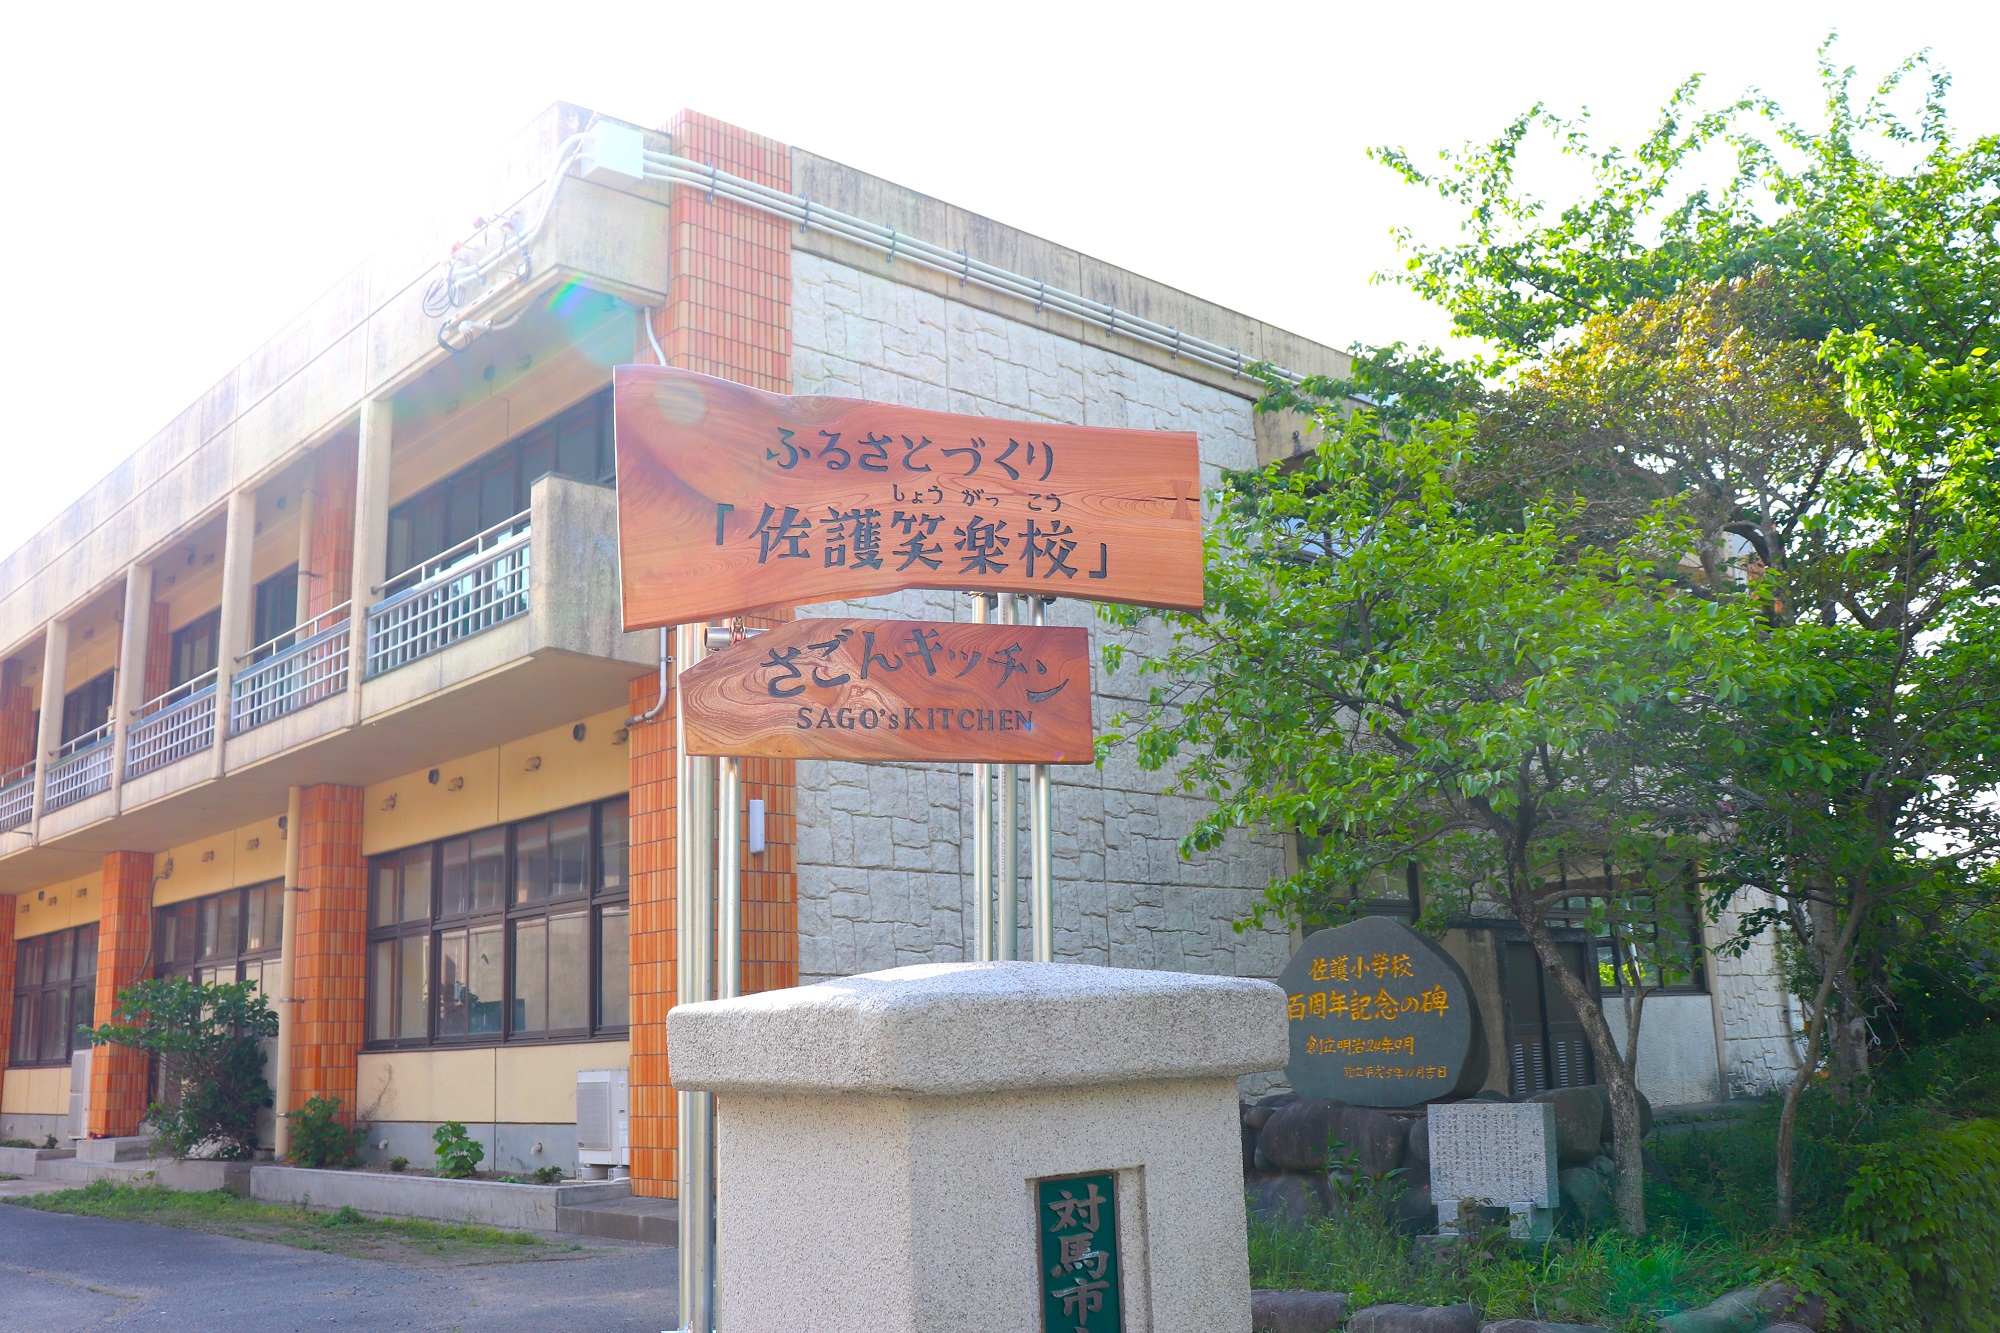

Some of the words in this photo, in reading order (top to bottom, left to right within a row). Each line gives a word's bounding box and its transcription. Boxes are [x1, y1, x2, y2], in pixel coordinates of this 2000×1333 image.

[766, 426, 1054, 482] ふるさとづくり
[893, 484, 945, 506] しょう
[961, 487, 1000, 507] がっ
[1027, 492, 1062, 513] こう
[715, 502, 1108, 579] 「佐護笑楽校」
[760, 628, 1069, 703] さごんキッチン
[1308, 953, 1415, 982] 佐護小学校
[1287, 983, 1449, 1021] 百周年記念の碑
[1047, 1183, 1110, 1333] 対馬市
